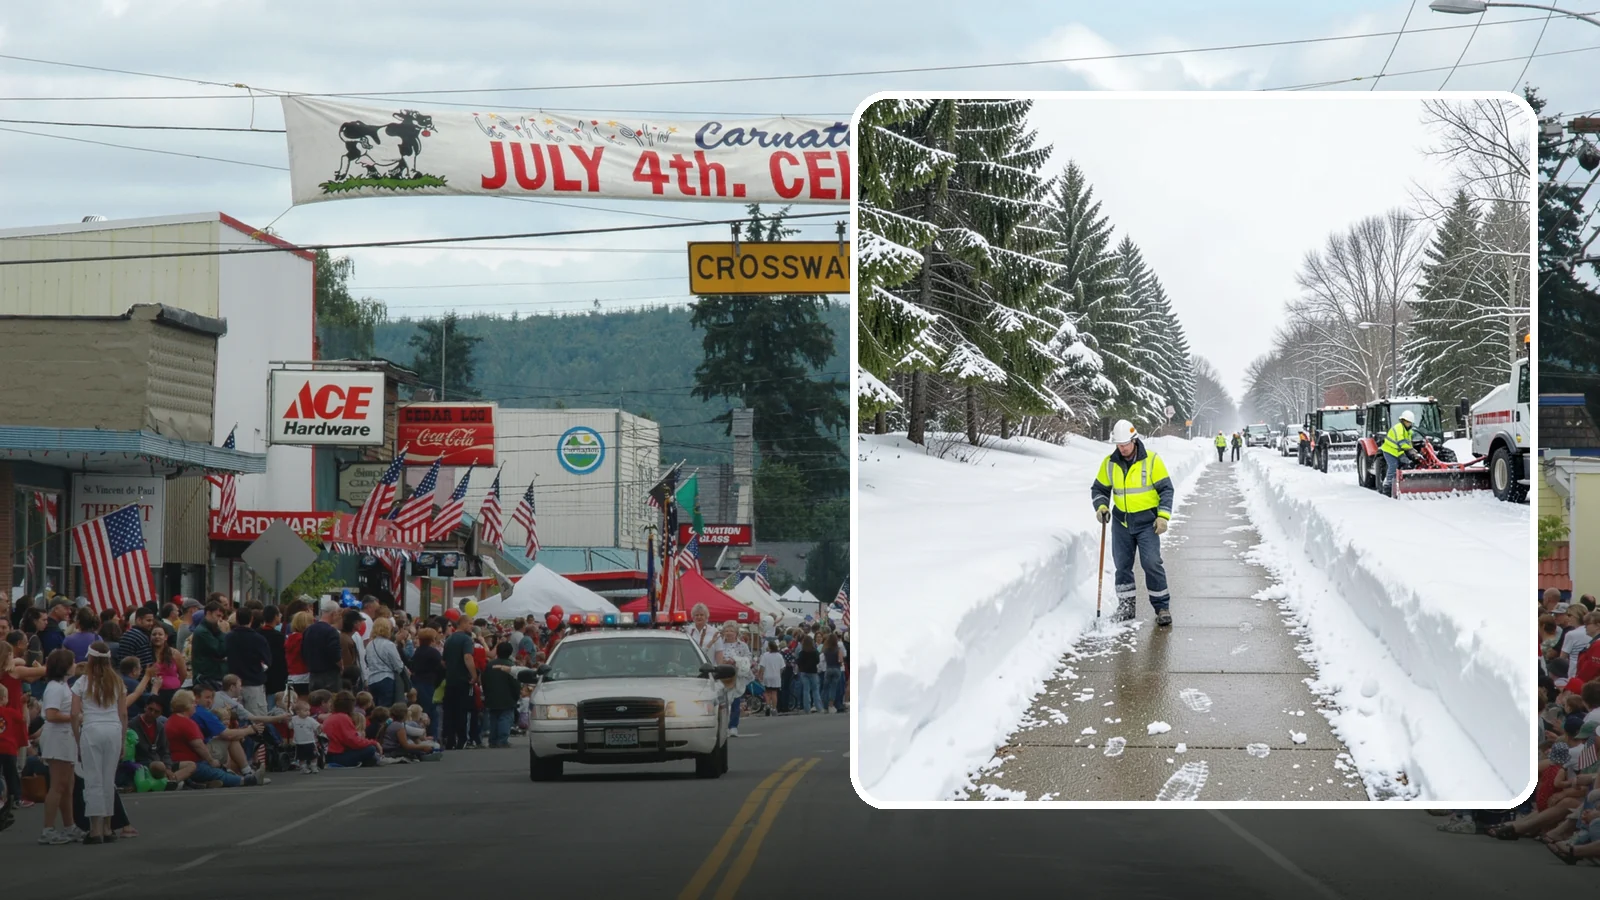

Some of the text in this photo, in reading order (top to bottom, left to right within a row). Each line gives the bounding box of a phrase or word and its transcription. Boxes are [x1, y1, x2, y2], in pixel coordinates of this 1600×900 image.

[481, 141, 605, 192] JULY
[632, 149, 746, 197] 4th.
[697, 254, 850, 280] CROSSWA
[282, 380, 373, 420] ACE
[406, 409, 452, 422] CEDAR
[283, 421, 370, 436] Hardware
[96, 485, 125, 495] Vincent
[126, 486, 136, 494] de
[137, 486, 155, 496] Paul
